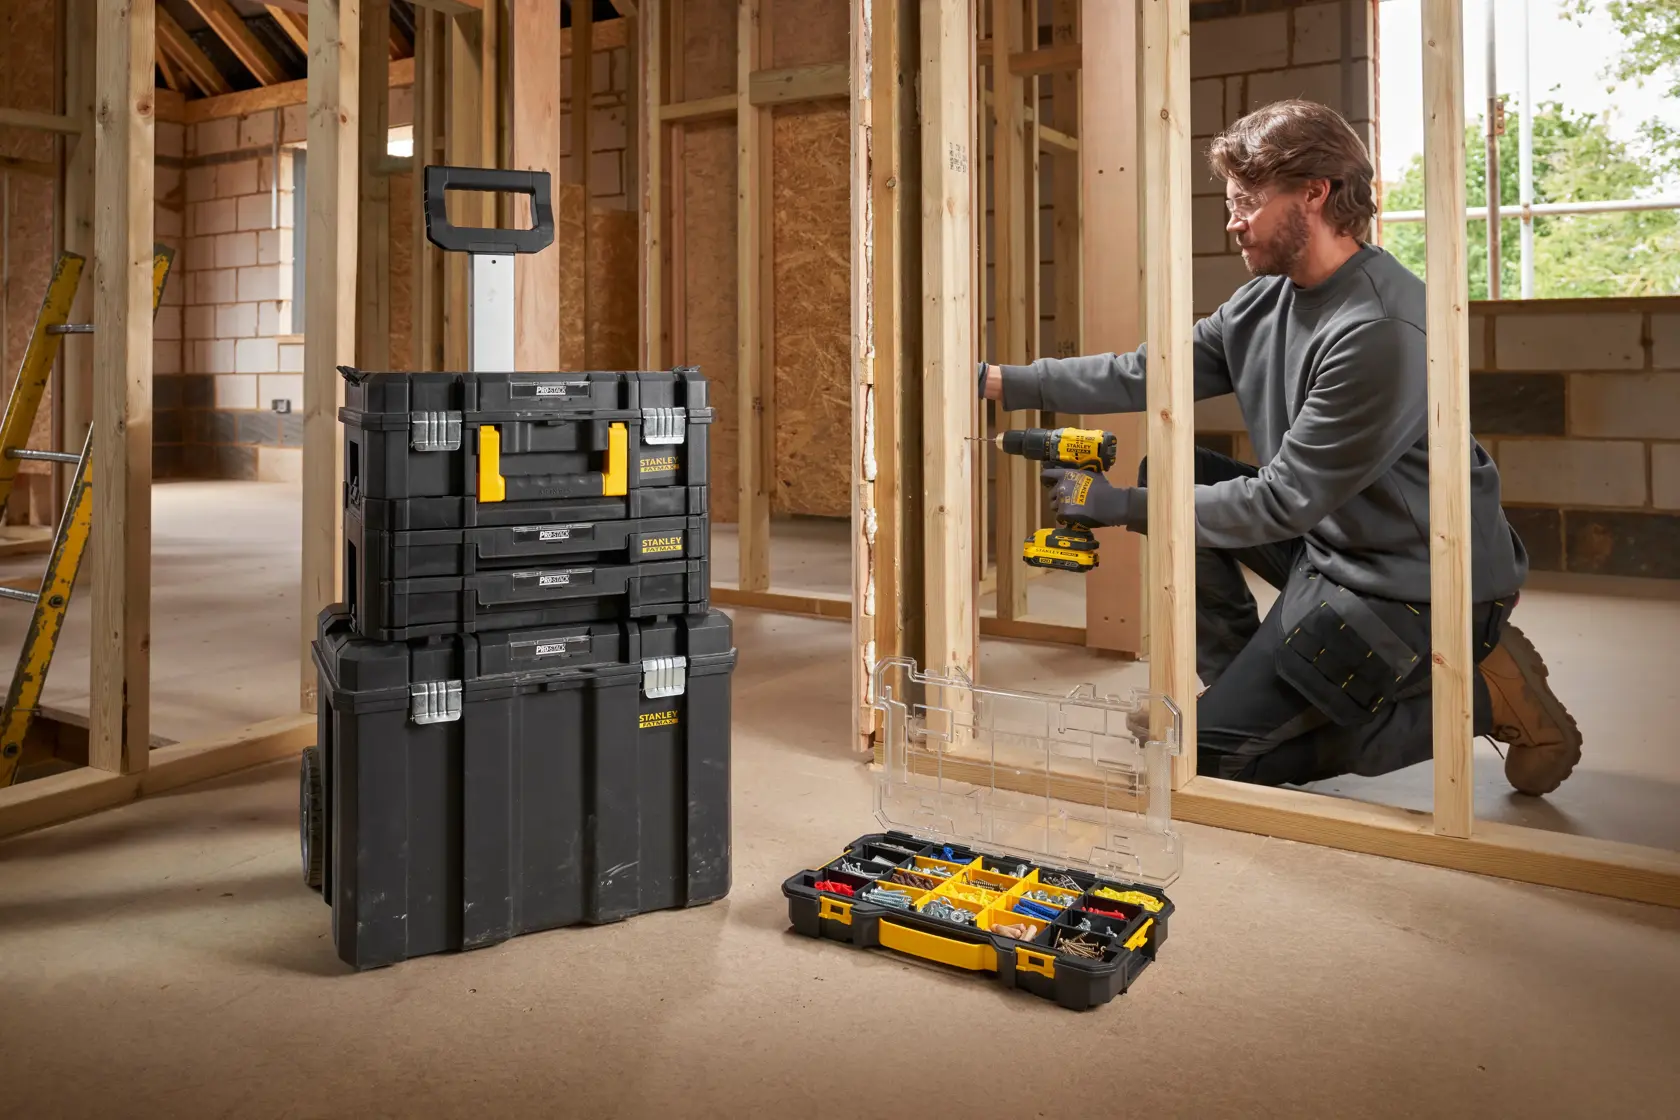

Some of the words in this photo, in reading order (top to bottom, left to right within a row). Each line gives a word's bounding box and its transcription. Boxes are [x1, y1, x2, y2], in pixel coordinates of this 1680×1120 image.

[640, 456, 678, 466] STANLEY
[1079, 477, 1092, 504] STANLEY
[642, 537, 681, 547] STANLEY
[639, 711, 677, 722] STANLEY
